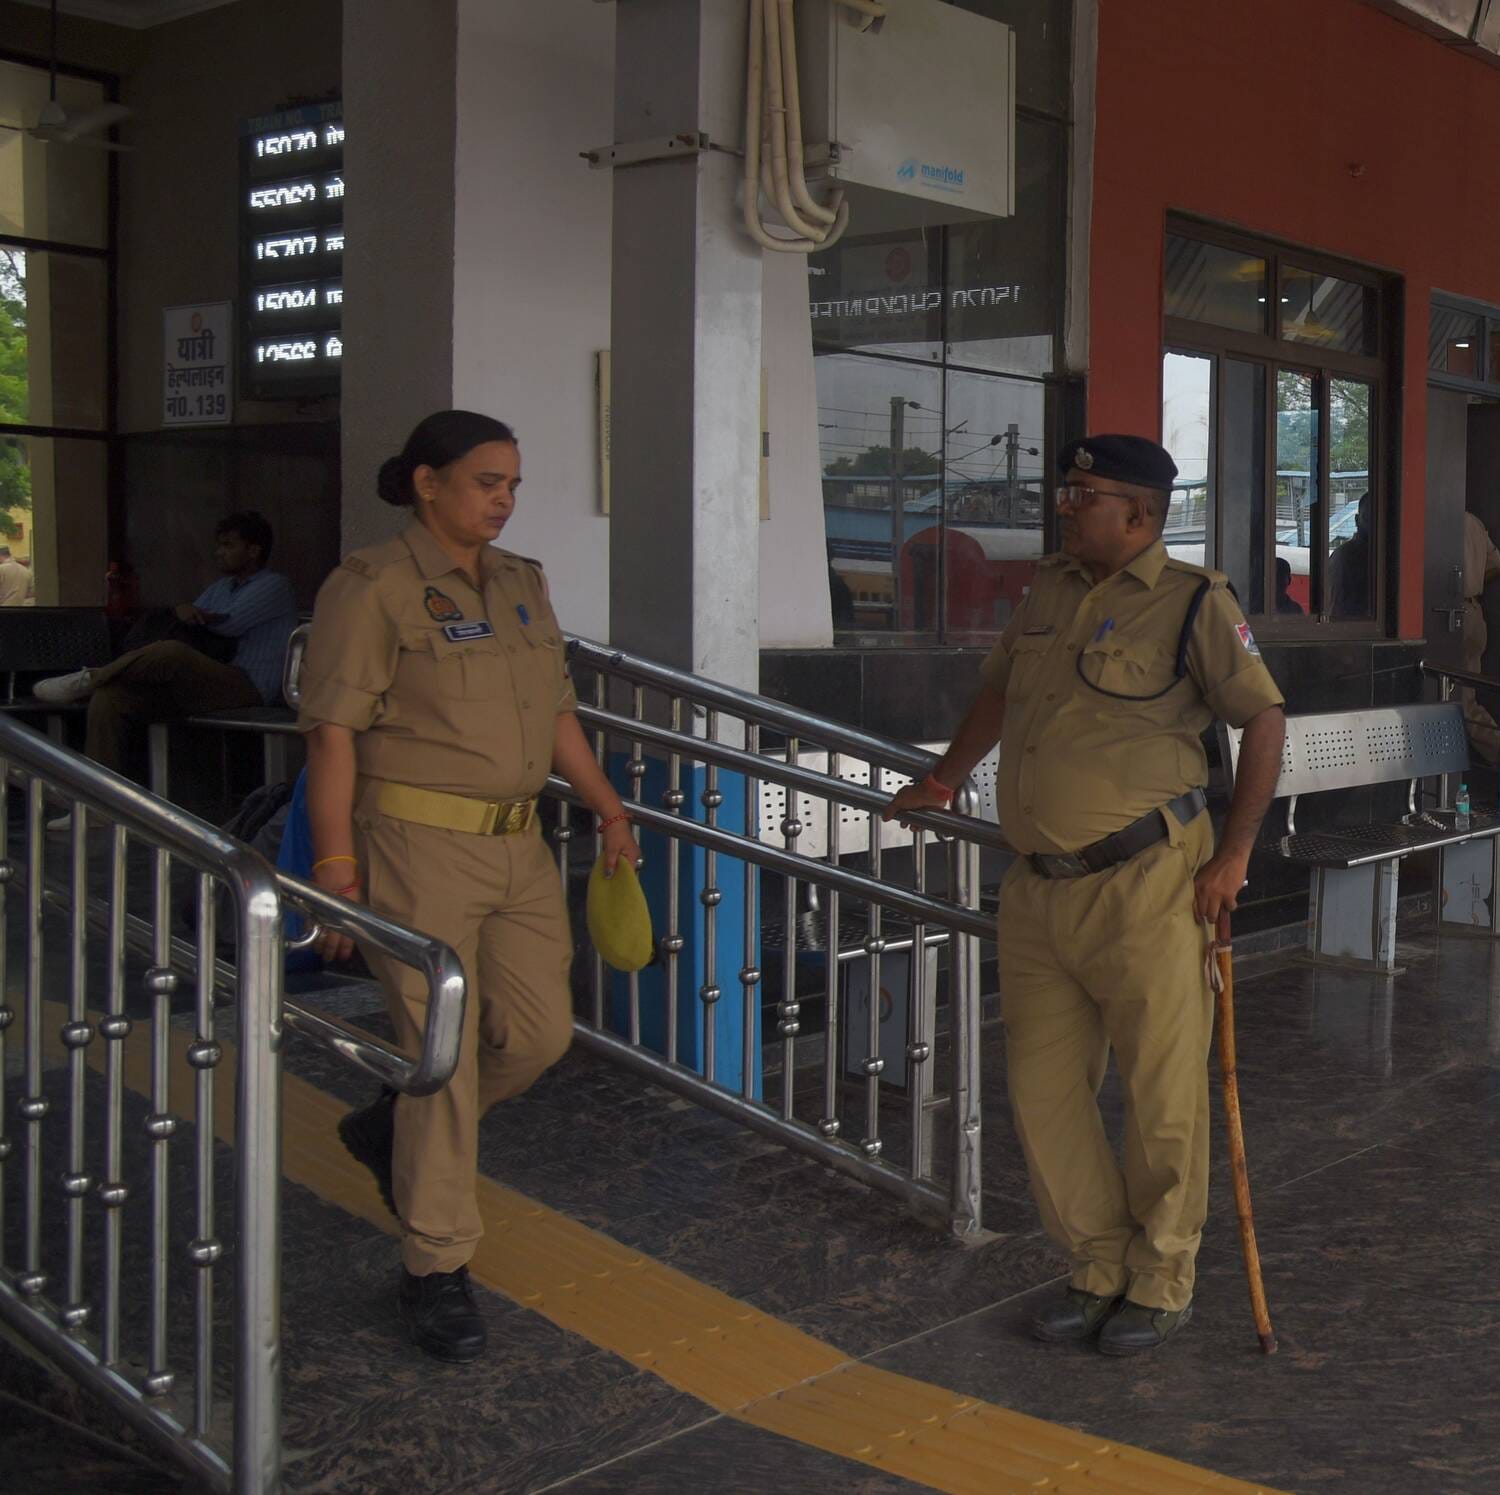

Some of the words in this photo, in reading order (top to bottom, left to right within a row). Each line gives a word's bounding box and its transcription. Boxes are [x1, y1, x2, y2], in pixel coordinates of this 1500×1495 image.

[921, 163, 964, 185] manifold
[177, 329, 216, 361] यात्री
[167, 363, 226, 389] हेल्पलाइन
